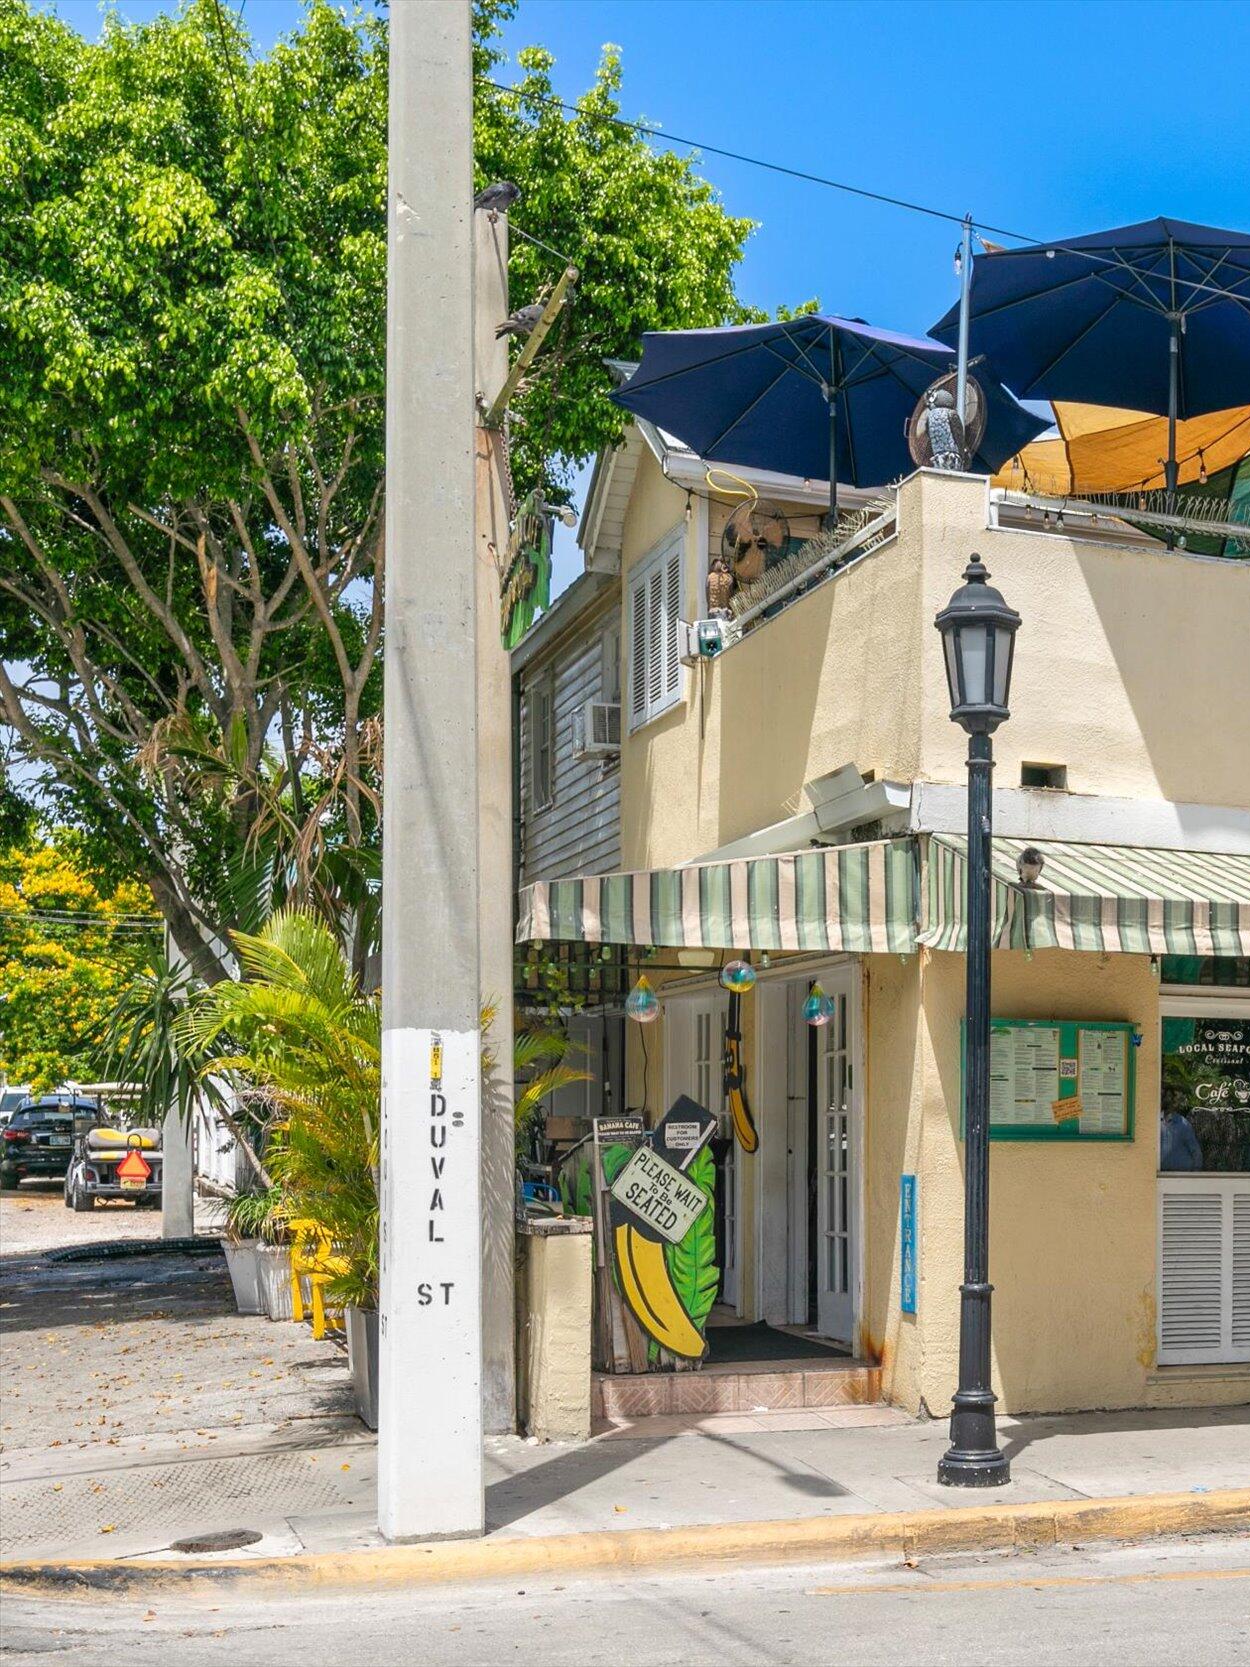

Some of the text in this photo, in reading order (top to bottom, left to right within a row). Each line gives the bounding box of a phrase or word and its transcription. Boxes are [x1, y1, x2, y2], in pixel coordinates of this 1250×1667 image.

[1179, 1043, 1215, 1054] LOCAL
[1195, 1081, 1232, 1105] Café
[417, 1094, 454, 1306] DUVAL ST
[625, 1182, 678, 1230] SEATED
[634, 1153, 703, 1212] PLEASE WAIT
[649, 1181, 672, 1205] To Be
[904, 1183, 912, 1303] ENTRANCE
